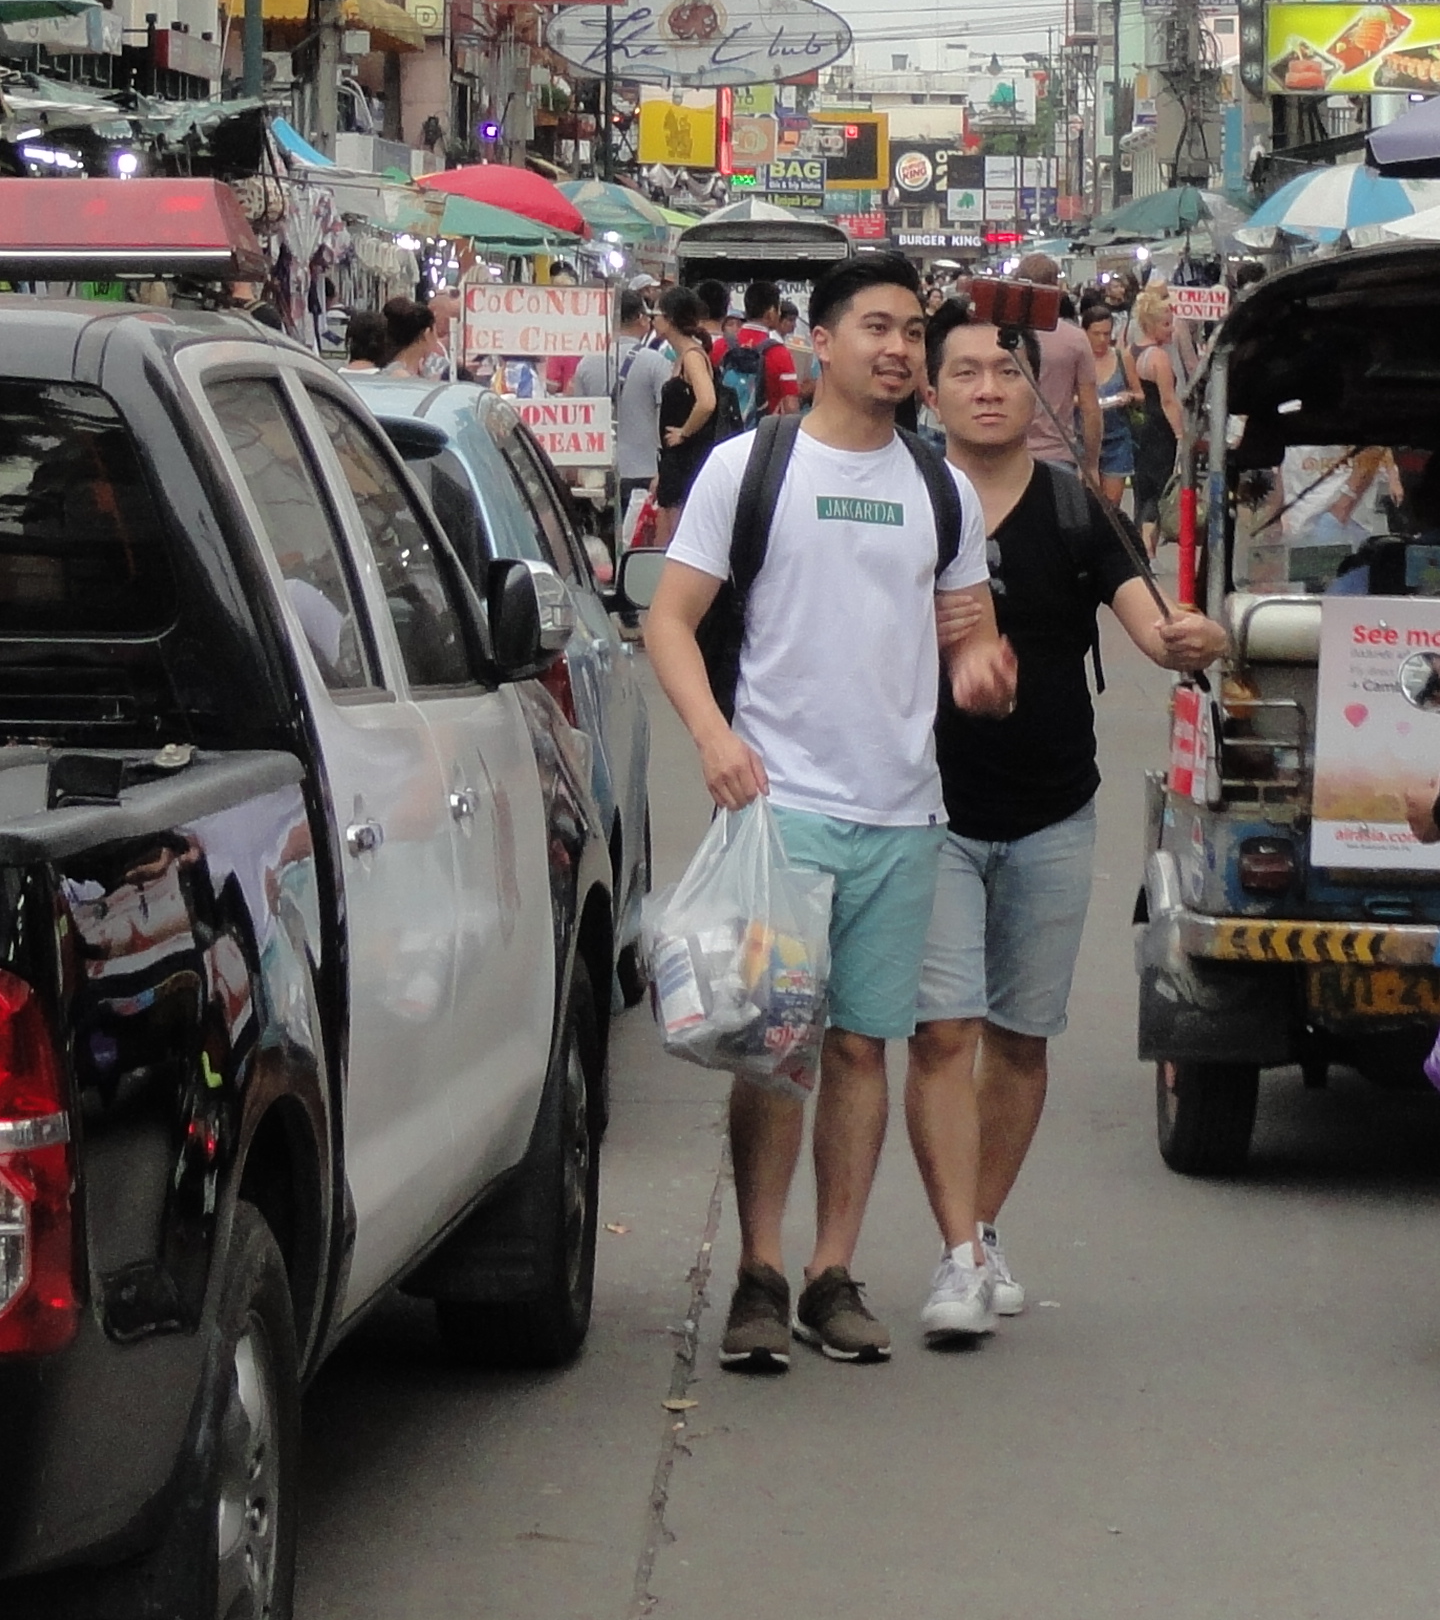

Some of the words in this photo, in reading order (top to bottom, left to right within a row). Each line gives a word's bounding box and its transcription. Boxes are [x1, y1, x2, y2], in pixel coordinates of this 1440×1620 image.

[711, 21, 832, 66] Club
[768, 161, 822, 179] BAG
[902, 168, 927, 181] KING
[898, 234, 947, 246] BURGER
[951, 234, 982, 247] KING
[824, 500, 896, 524] JAK(ART)A
[1352, 625, 1399, 645] See
